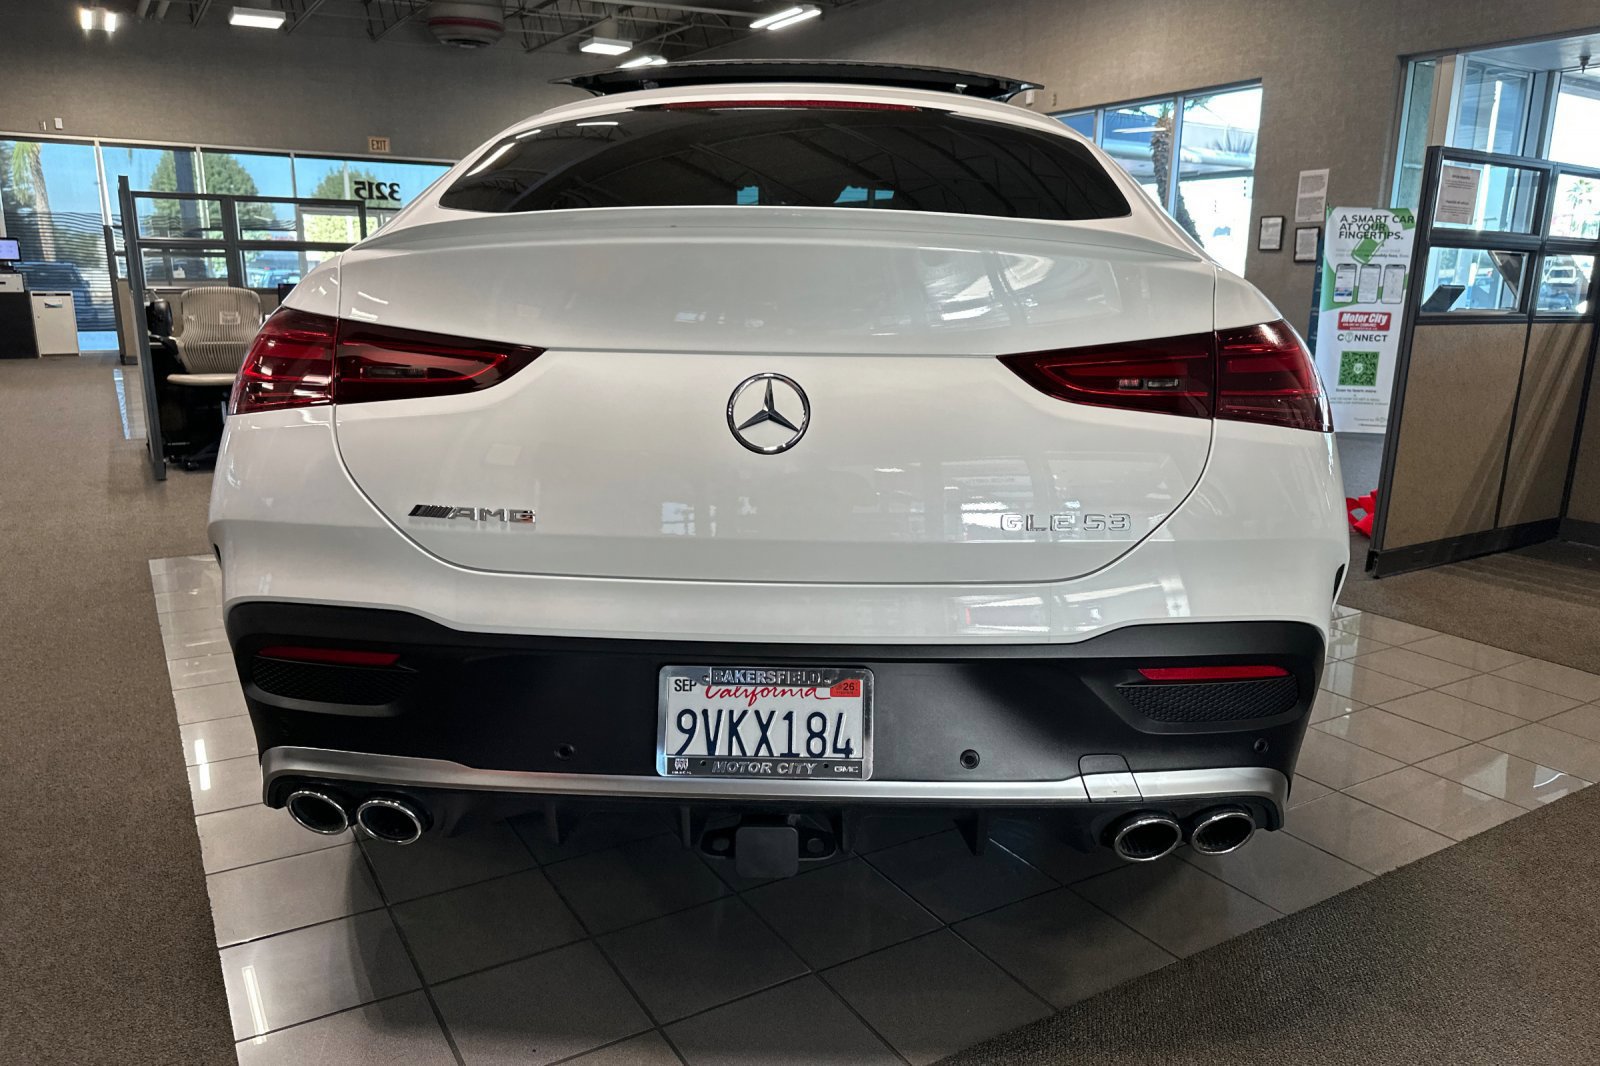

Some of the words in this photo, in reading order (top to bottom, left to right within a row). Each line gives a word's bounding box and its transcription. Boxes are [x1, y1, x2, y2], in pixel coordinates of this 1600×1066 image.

[371, 139, 387, 151] EXIT
[1340, 214, 1348, 223] A
[1351, 214, 1389, 223] SMART
[1392, 215, 1415, 224] CAR
[1339, 223, 1353, 231] AT
[1355, 223, 1386, 231] YOUR
[1338, 231, 1404, 240] FINGERTIPS.
[1341, 313, 1368, 323] Motor
[1368, 313, 1388, 326] City
[448, 506, 536, 523] AMG
[1000, 513, 1073, 532] GLE
[1083, 513, 1132, 532] 53
[713, 669, 820, 684] BAKERSFIELD
[674, 678, 697, 692] SEP
[843, 682, 855, 691] 26
[675, 708, 855, 759] 9VKX184
[712, 761, 771, 774] MOTOR
[776, 762, 817, 775] CITY
[834, 765, 859, 773] GMC
